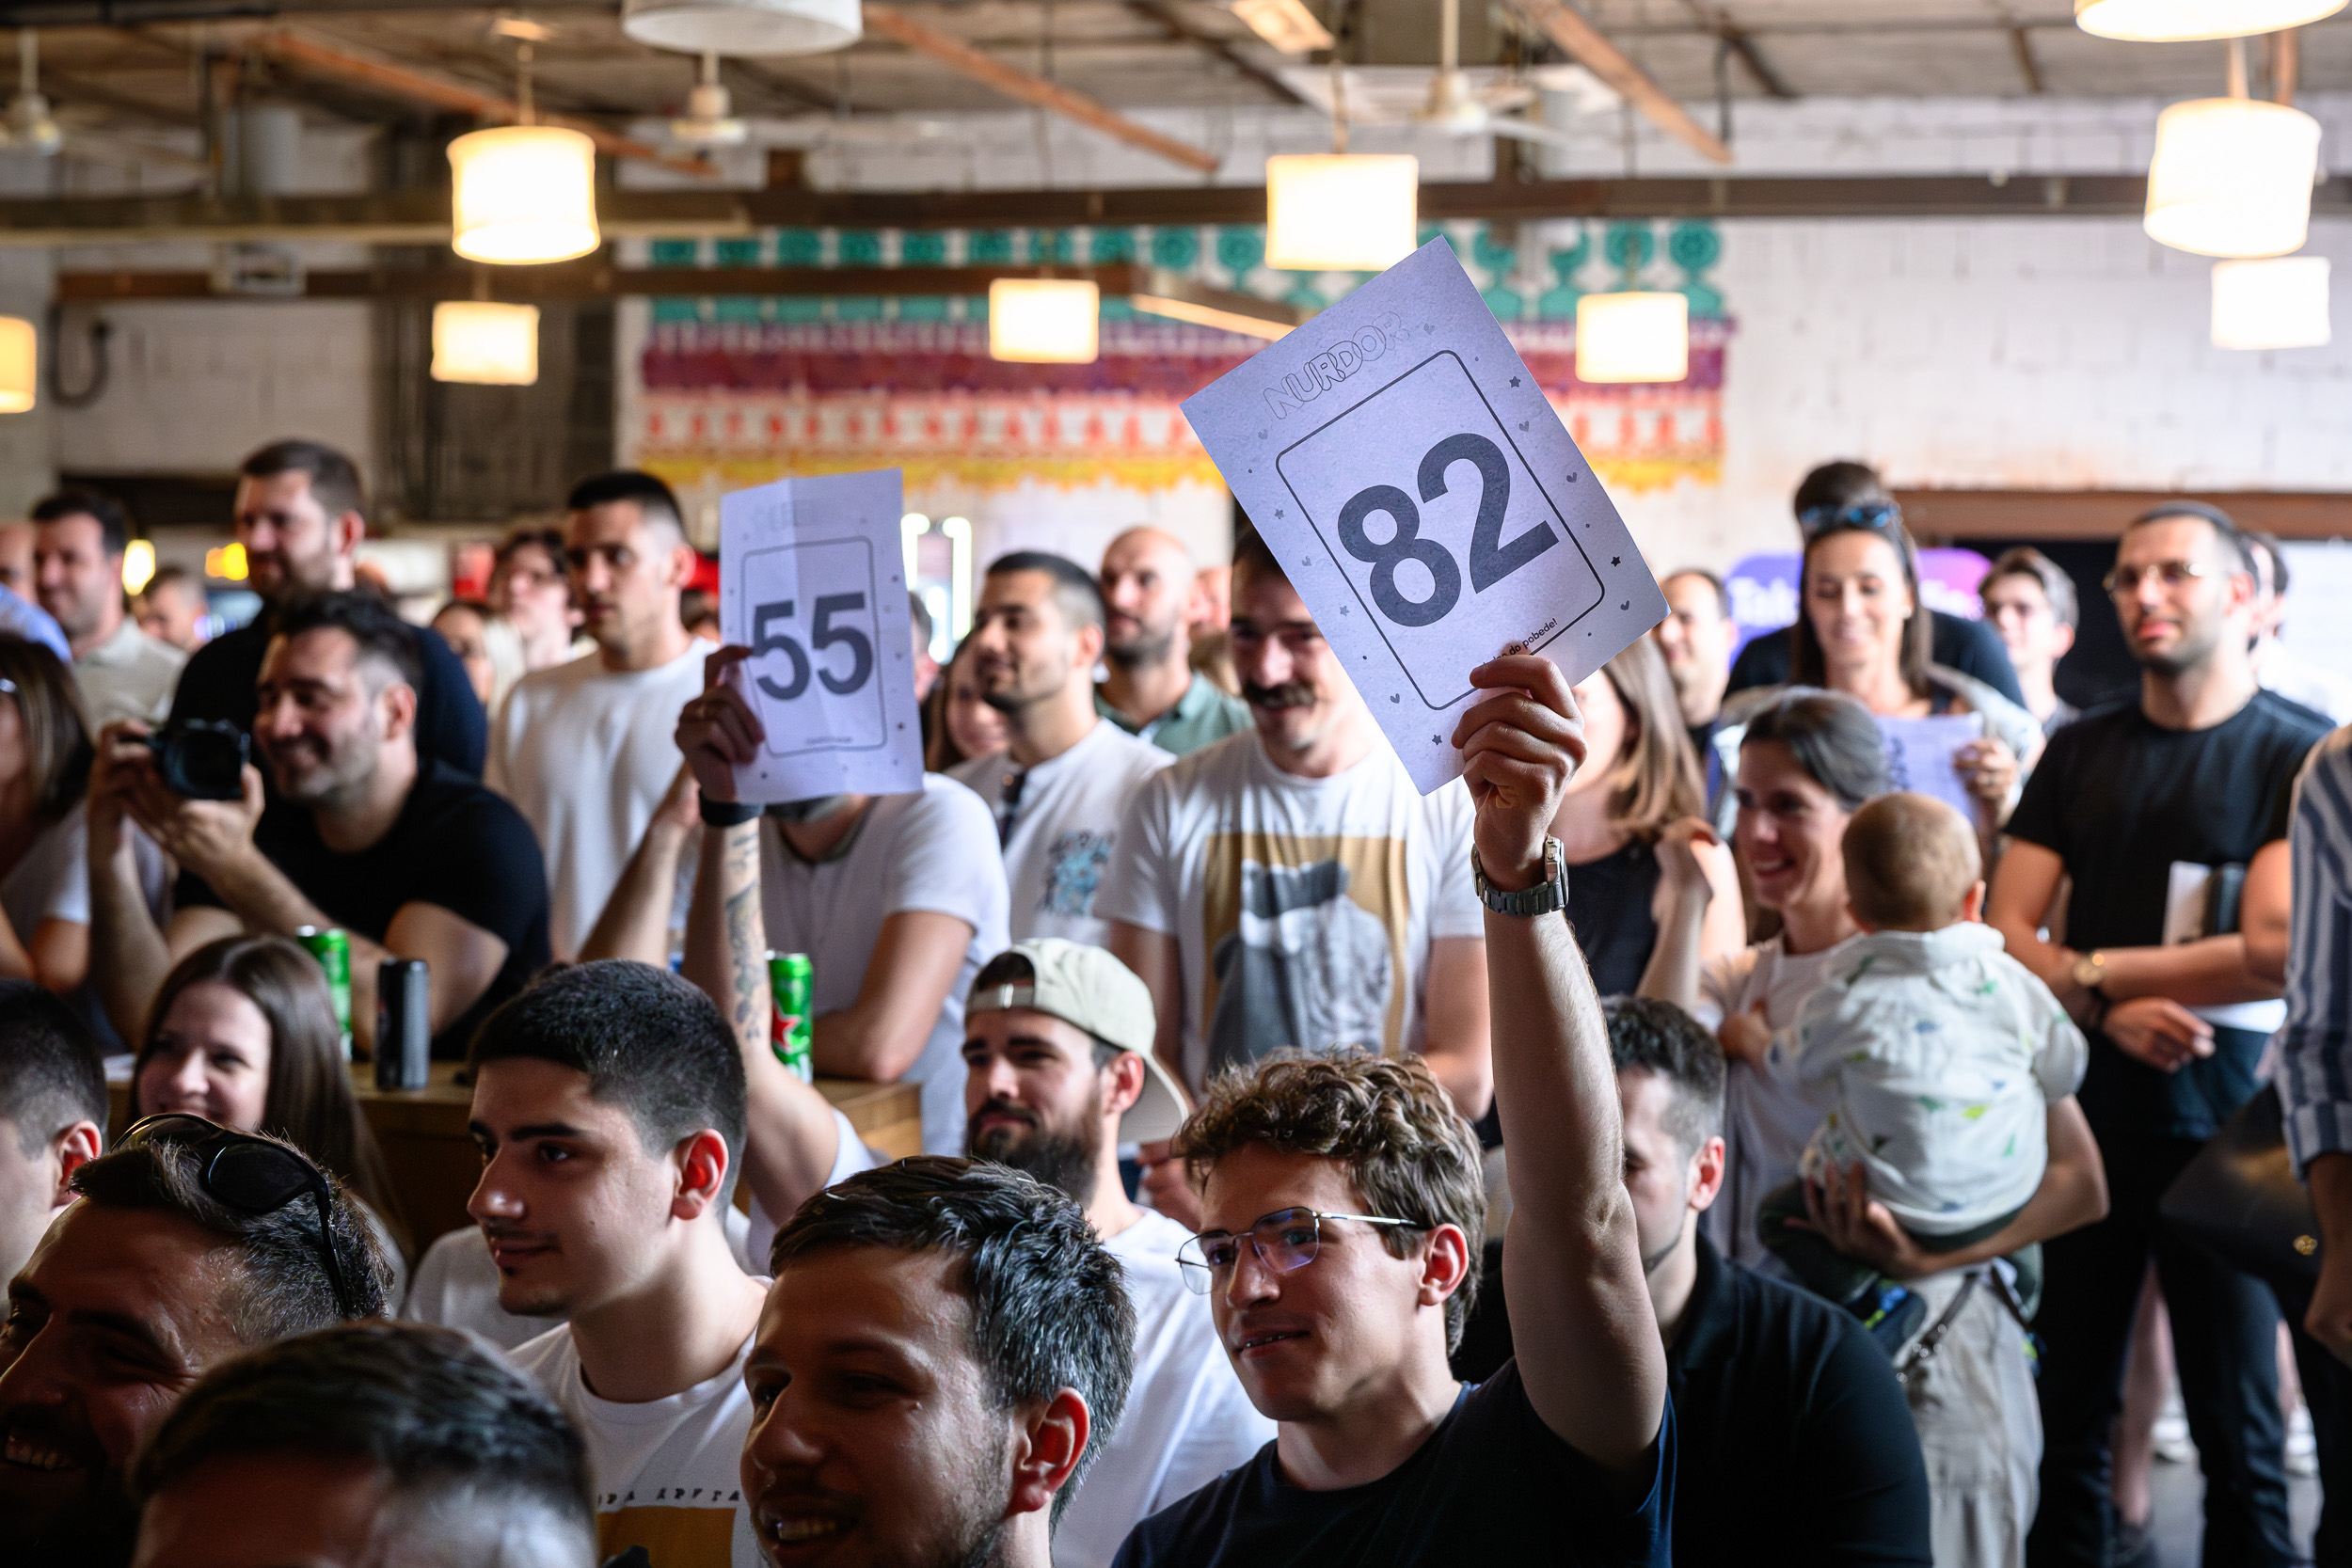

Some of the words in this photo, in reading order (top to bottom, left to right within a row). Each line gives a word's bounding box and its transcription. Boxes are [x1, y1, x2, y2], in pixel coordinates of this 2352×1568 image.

[1263, 311, 1410, 420] NURDOR
[1338, 433, 1560, 627] 82
[752, 592, 873, 701] 55
[1509, 644, 1521, 656] do
[1522, 617, 1558, 649] pobede!
